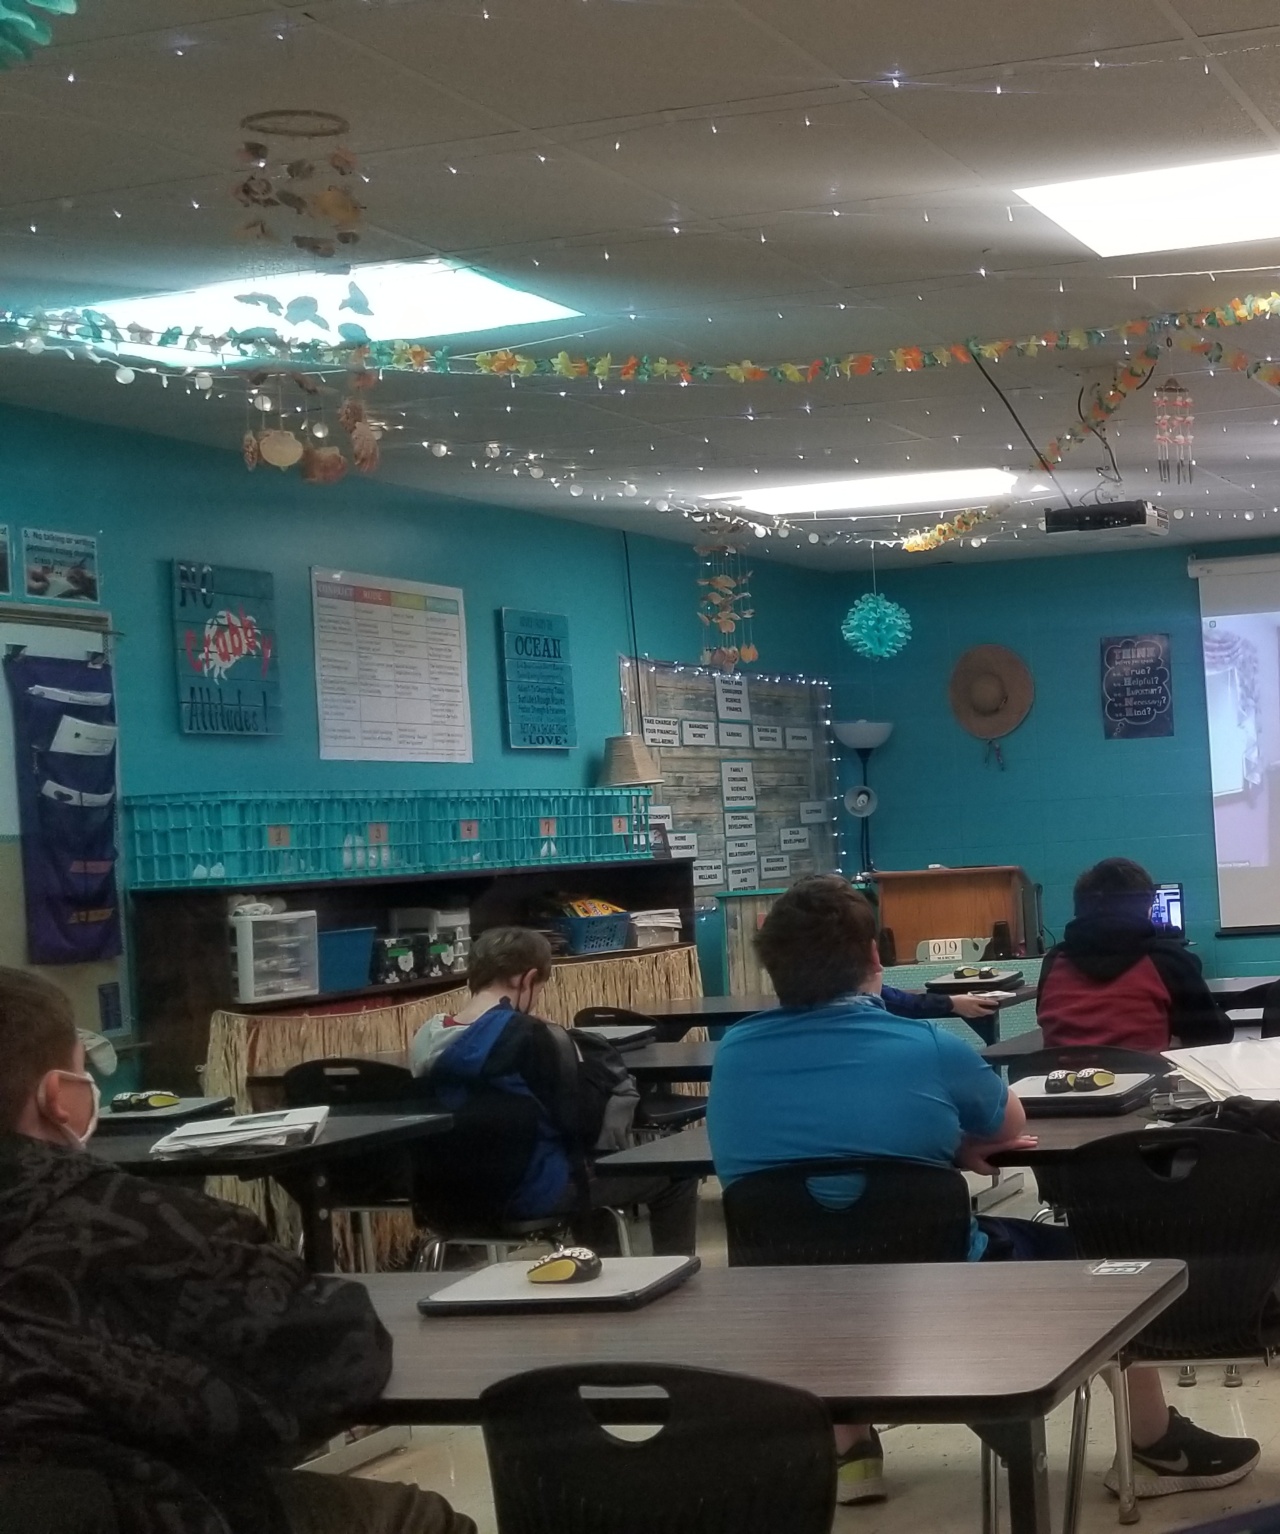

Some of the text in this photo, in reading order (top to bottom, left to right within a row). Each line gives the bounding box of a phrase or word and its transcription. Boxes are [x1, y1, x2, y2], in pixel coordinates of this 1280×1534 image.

[179, 564, 214, 608] NO
[185, 603, 272, 680] Crabby
[514, 635, 562, 659] OCEAN
[1113, 647, 1156, 660] THINK
[1124, 666, 1151, 677] True?
[1123, 676, 1159, 687] Helpful?
[1124, 695, 1167, 707] Necessary?
[1125, 706, 1152, 717] Kind?
[529, 735, 562, 745] LOVE
